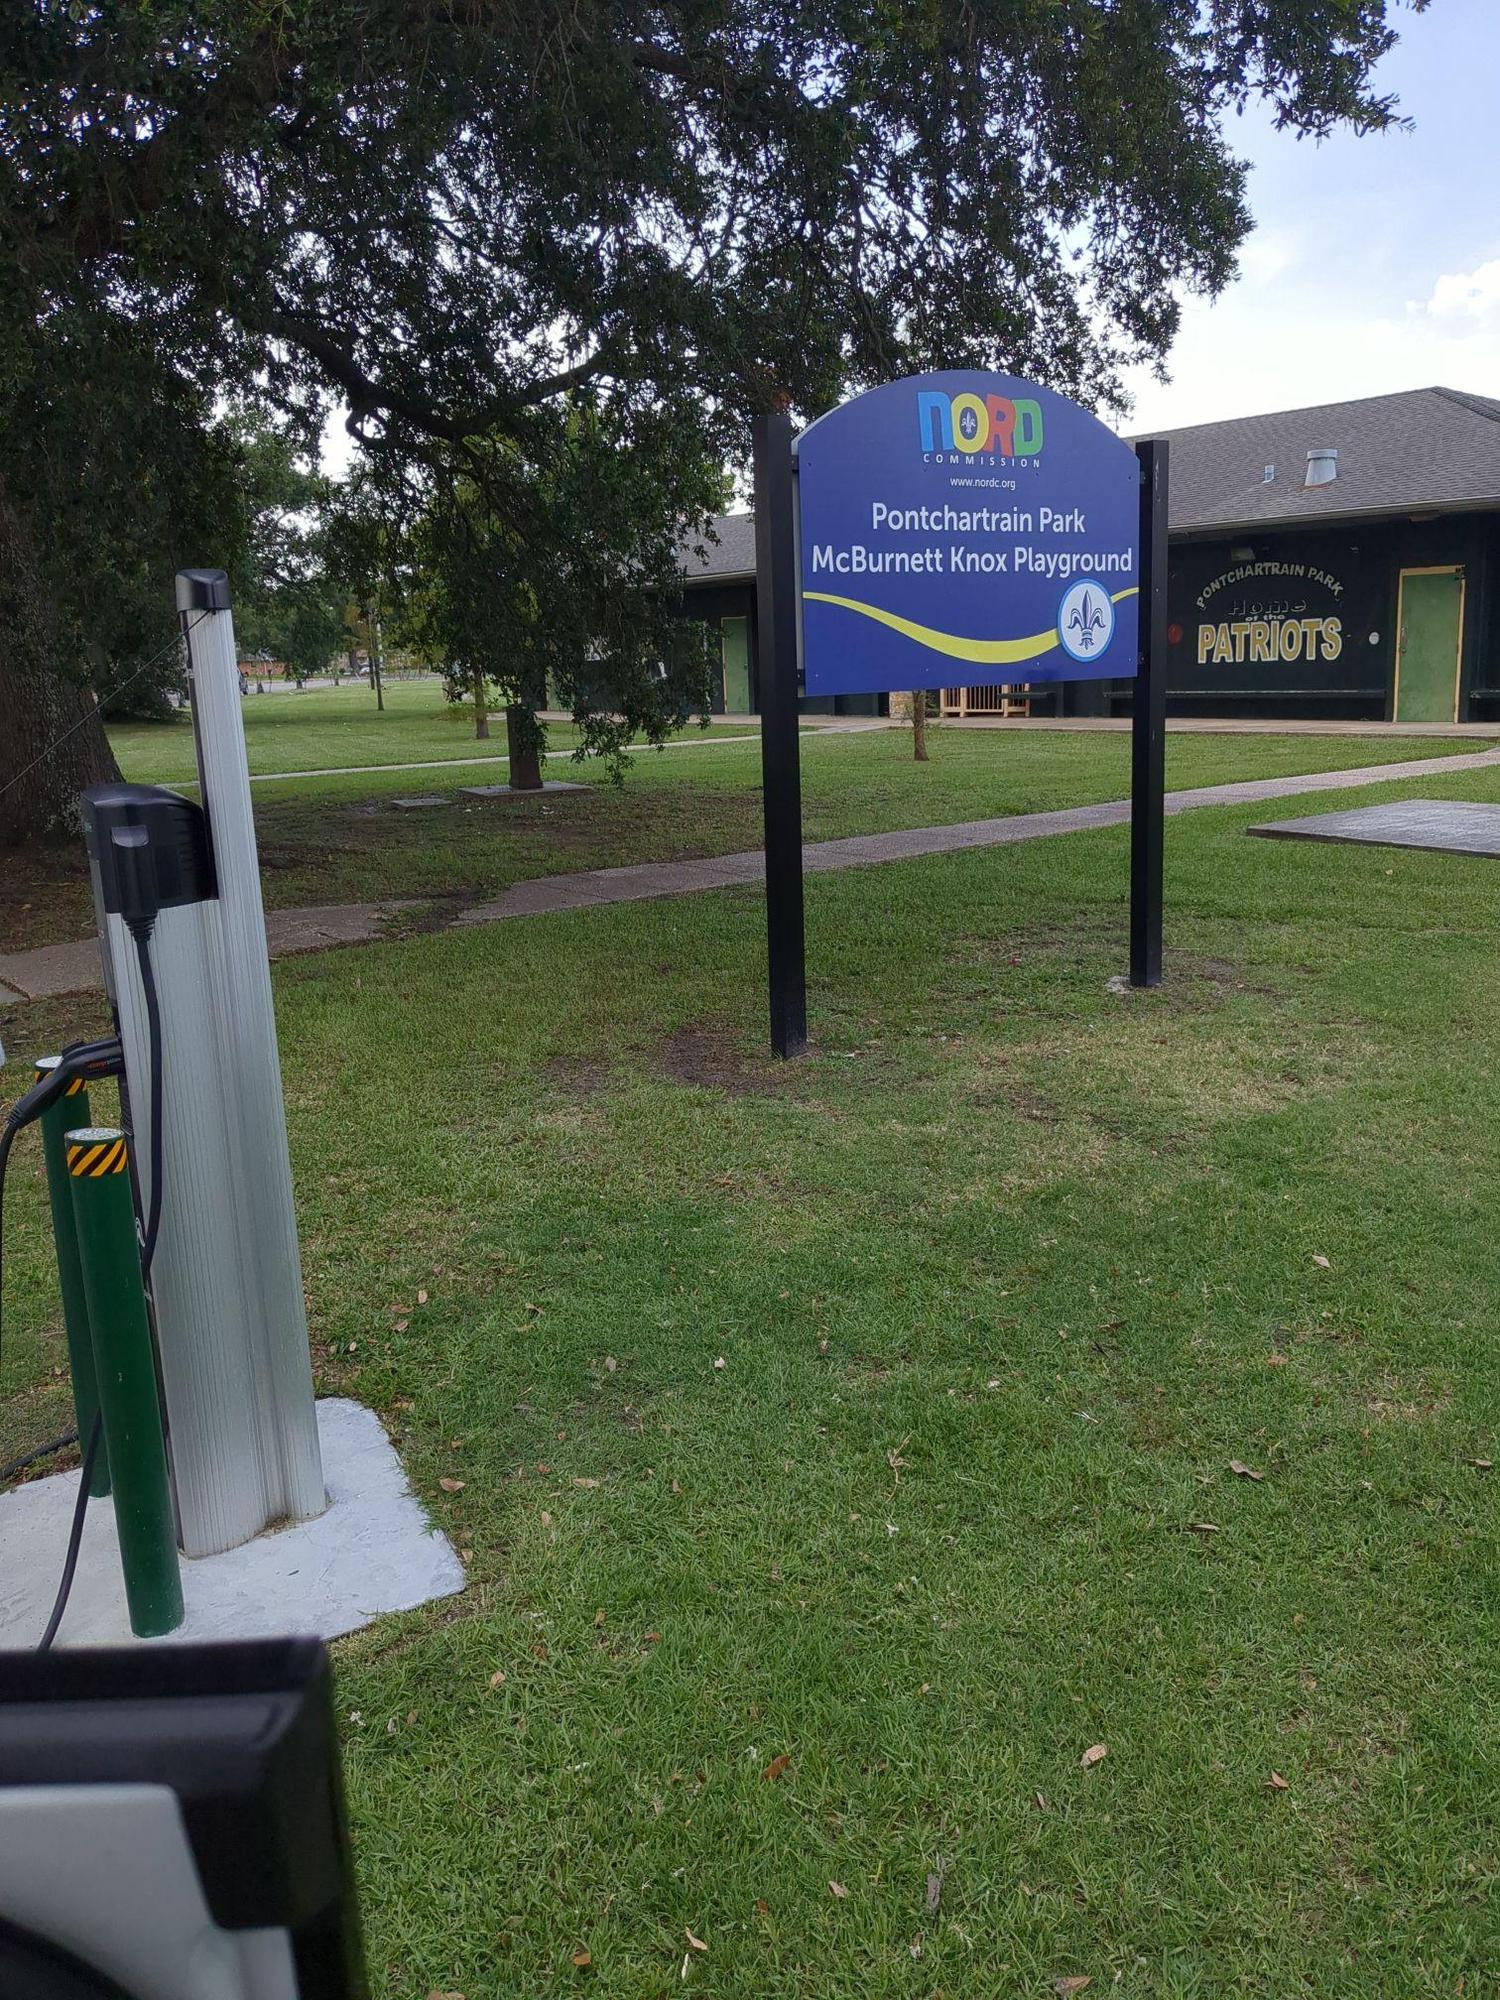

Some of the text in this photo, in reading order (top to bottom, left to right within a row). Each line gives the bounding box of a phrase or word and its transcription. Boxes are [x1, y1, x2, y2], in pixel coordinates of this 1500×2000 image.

[923, 454, 1041, 468] COMMISSION
[949, 477, 1017, 491] www.nordc.org
[872, 502, 1086, 533] Pontchartrain Park
[812, 545, 1133, 579] McBurnett Knox Playground
[1196, 561, 1344, 610] PONTCHARTRAIN PARK
[1263, 613, 1286, 621] the
[1197, 616, 1343, 664] PATRIOTS
